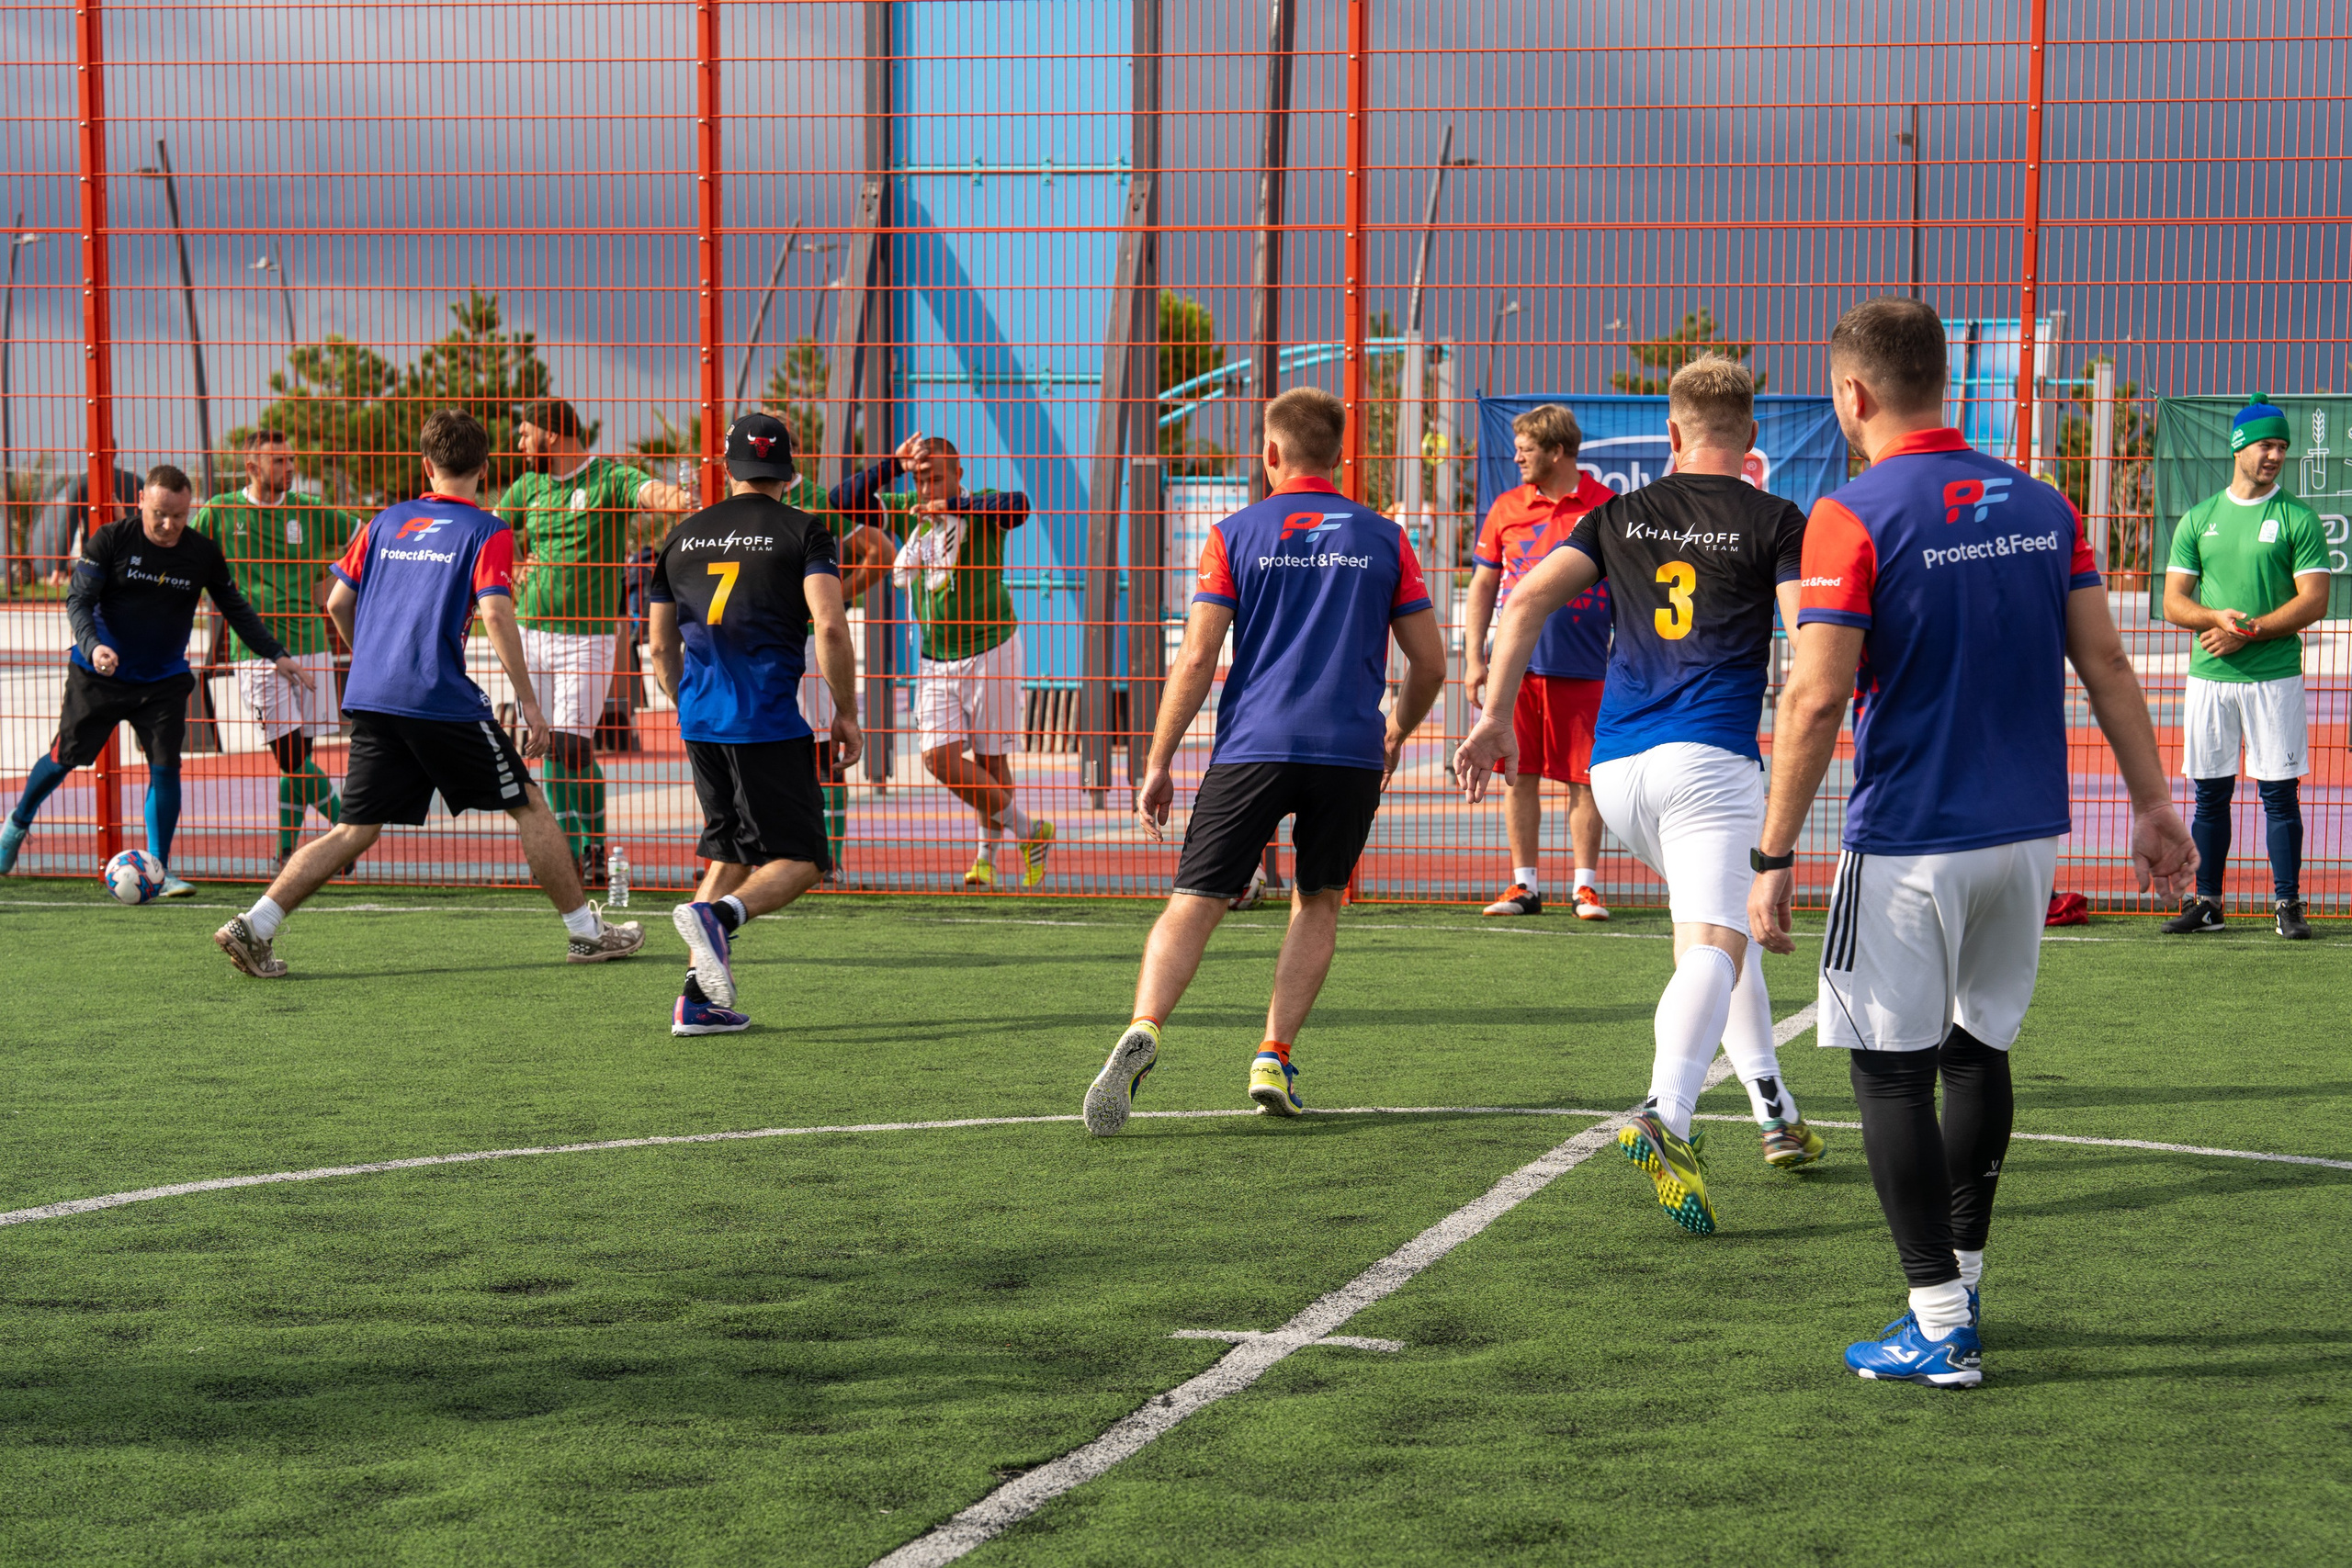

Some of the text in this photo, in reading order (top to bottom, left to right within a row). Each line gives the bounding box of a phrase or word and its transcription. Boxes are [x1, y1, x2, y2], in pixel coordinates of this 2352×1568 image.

[1258, 552, 1369, 570] Protect&Feed
[1922, 530, 2058, 570] Protect&Feed
[707, 561, 741, 626] 7
[1654, 560, 1696, 640] 3
